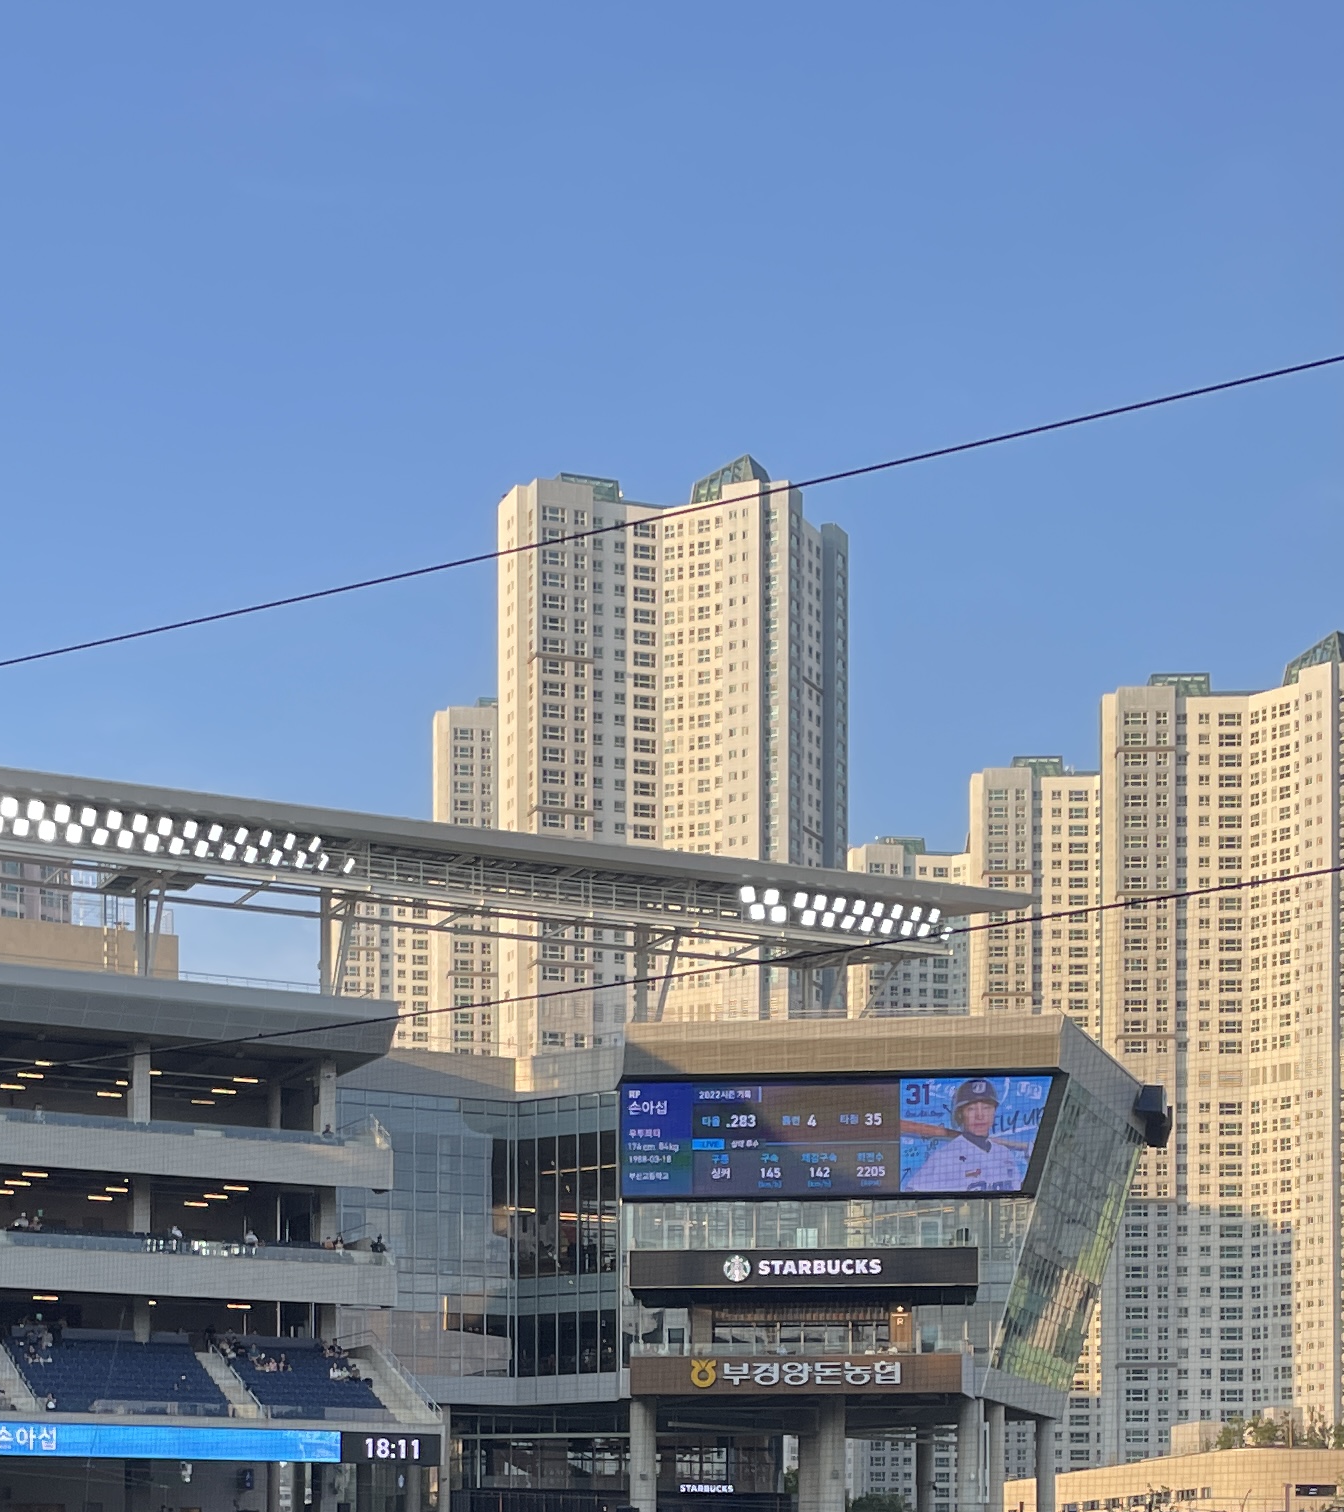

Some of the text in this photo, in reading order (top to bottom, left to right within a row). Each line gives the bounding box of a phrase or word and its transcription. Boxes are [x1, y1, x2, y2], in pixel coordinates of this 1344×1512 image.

[906, 1084, 930, 1105] 31
[628, 1100, 668, 1115] 손아섭
[726, 1114, 756, 1128] .283
[807, 1114, 817, 1127] 4
[864, 1113, 882, 1126] 35
[760, 1167, 781, 1178] 145
[809, 1167, 830, 1178] 142
[856, 1166, 885, 1177] 2205
[758, 1259, 882, 1275] STARBUCKS
[723, 1361, 901, 1386] 부경양돈농협
[365, 1438, 420, 1459] 18:11
[680, 1484, 734, 1493] STARBUCKS
